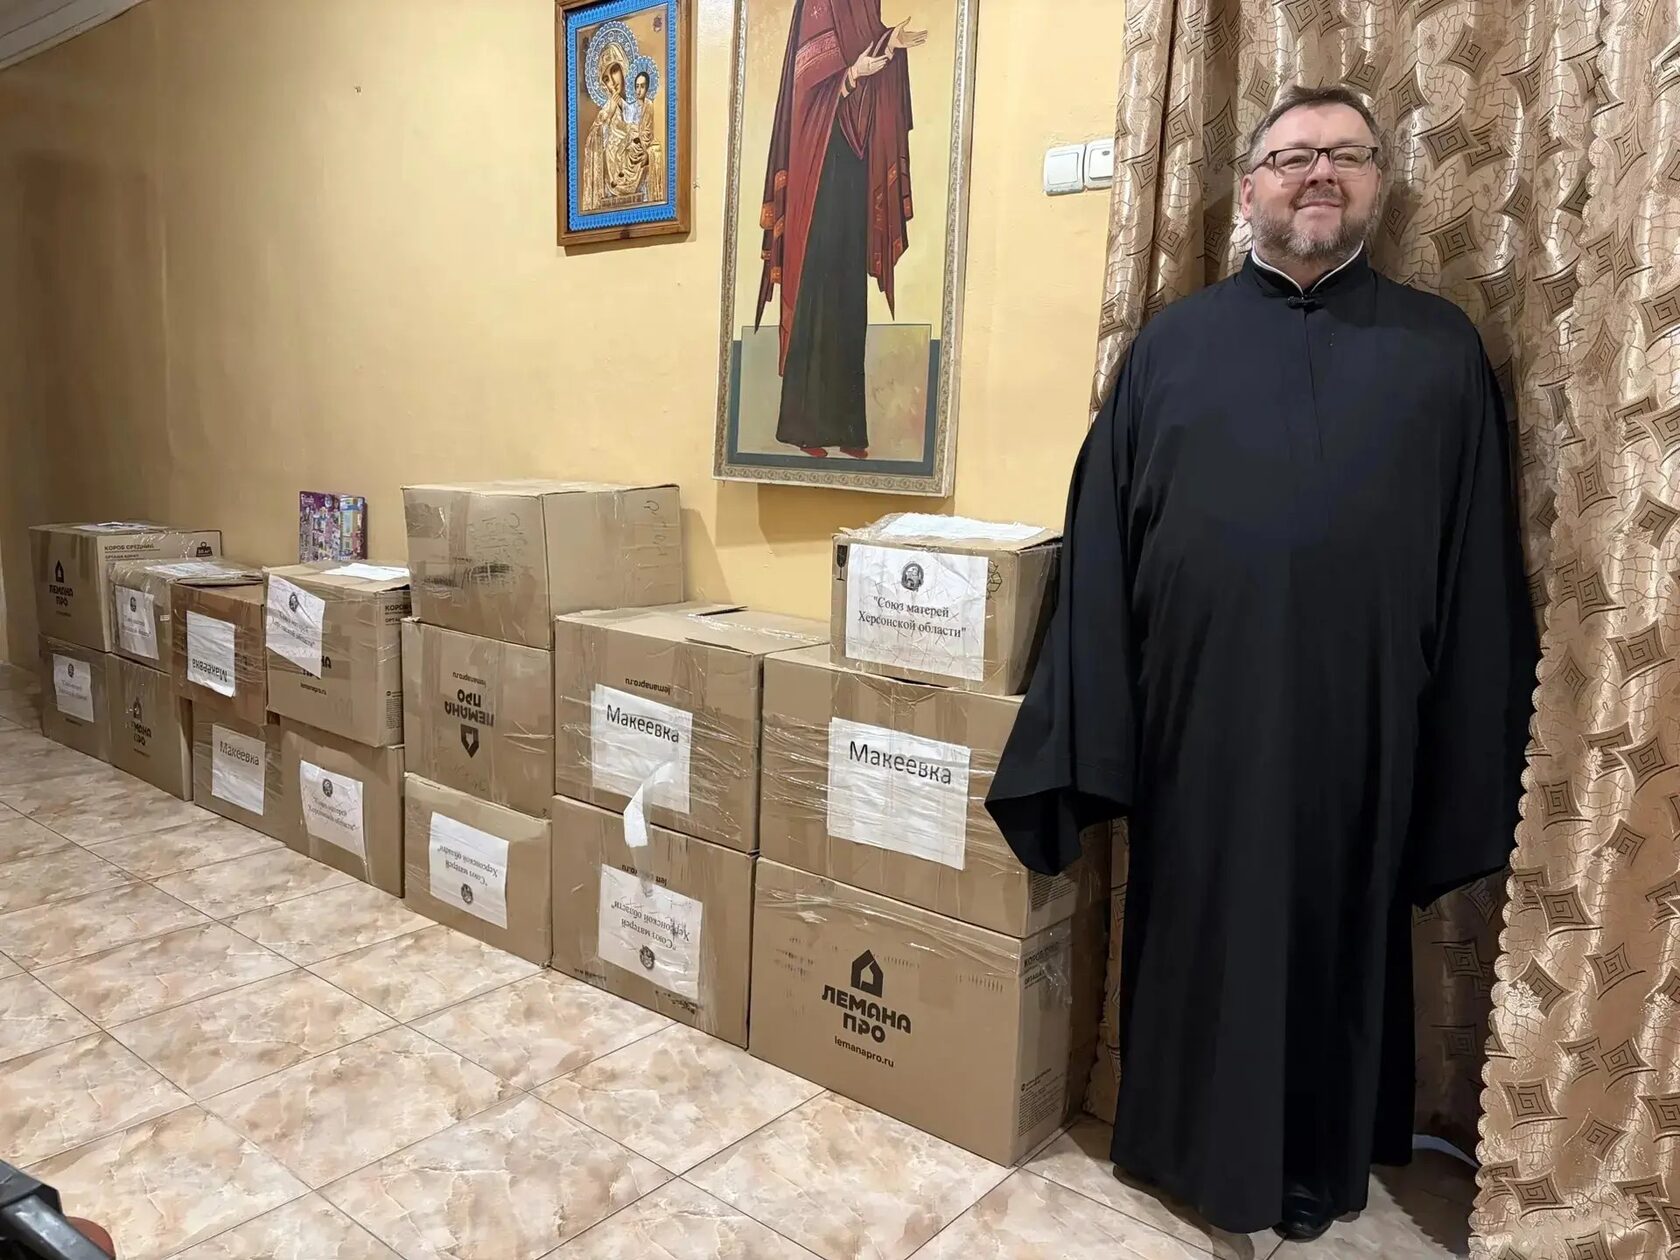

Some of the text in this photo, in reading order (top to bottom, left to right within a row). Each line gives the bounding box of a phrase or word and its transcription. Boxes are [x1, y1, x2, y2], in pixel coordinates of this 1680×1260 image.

[873, 596, 949, 618] "Союз матерей
[858, 610, 966, 638] Херсонской области"
[192, 658, 228, 683] Макеевка
[457, 689, 482, 708] ПРО
[625, 678, 671, 695] lemanapro.ru
[444, 700, 494, 727] ЛЕМАНА
[606, 704, 679, 743] Макеевка
[219, 741, 260, 765] Макеевка
[849, 740, 952, 785] Макеевка
[821, 984, 912, 1034] ЛЕМАНА
[842, 1012, 886, 1043] ПРО
[834, 1035, 895, 1068] lemanapro.ru
